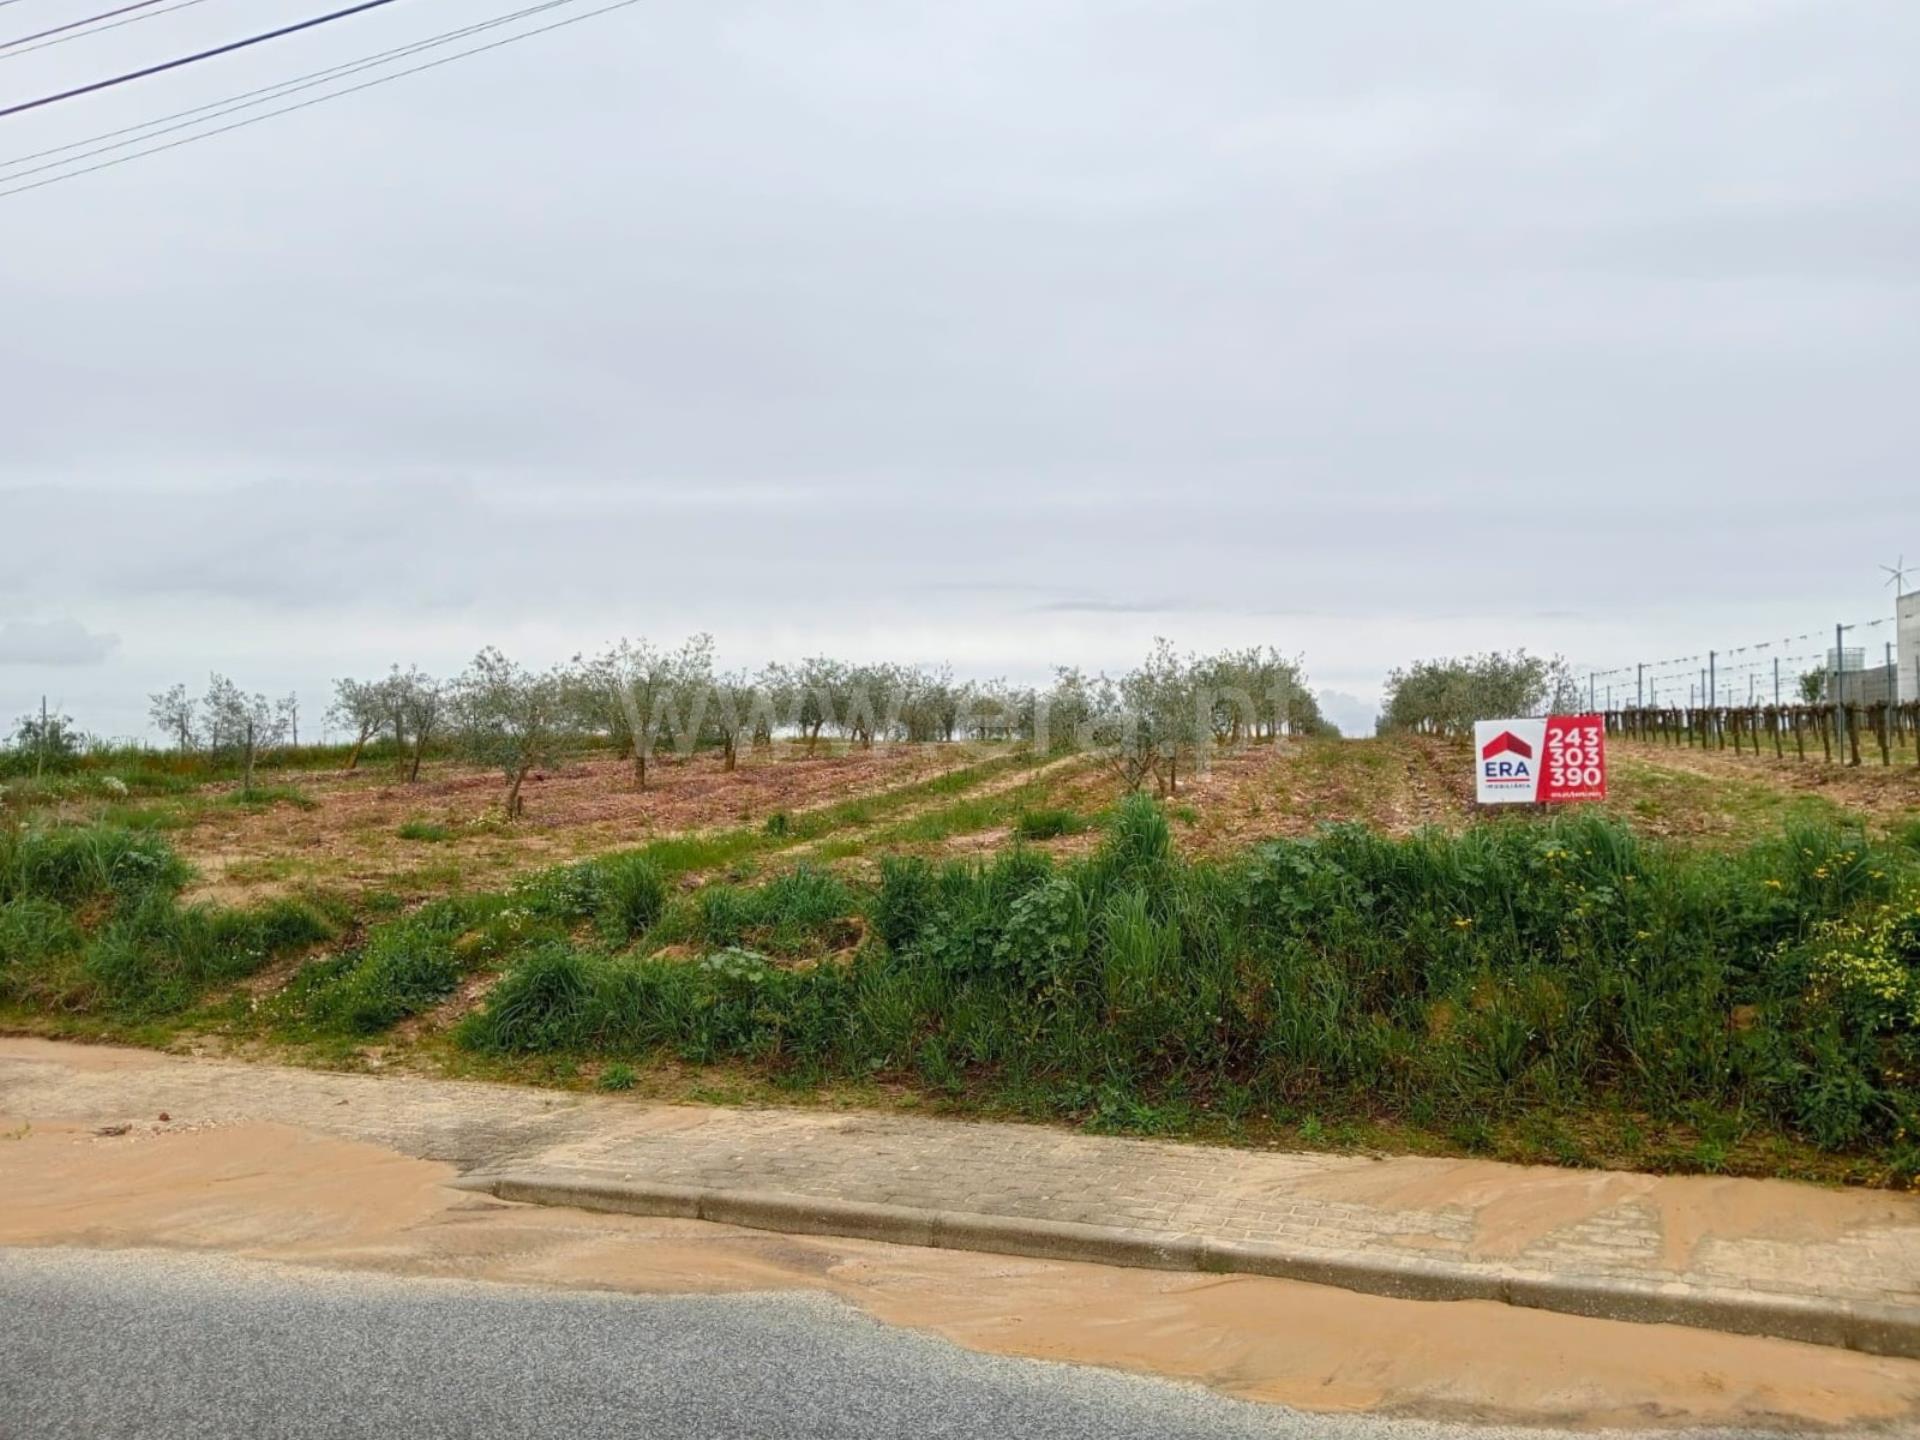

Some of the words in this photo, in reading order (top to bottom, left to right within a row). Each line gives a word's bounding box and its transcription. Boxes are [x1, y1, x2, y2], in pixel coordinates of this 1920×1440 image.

[1549, 727, 1599, 747] 243
[1549, 747, 1600, 767] 303
[1485, 761, 1530, 777] ERA
[1549, 767, 1602, 787] 390
